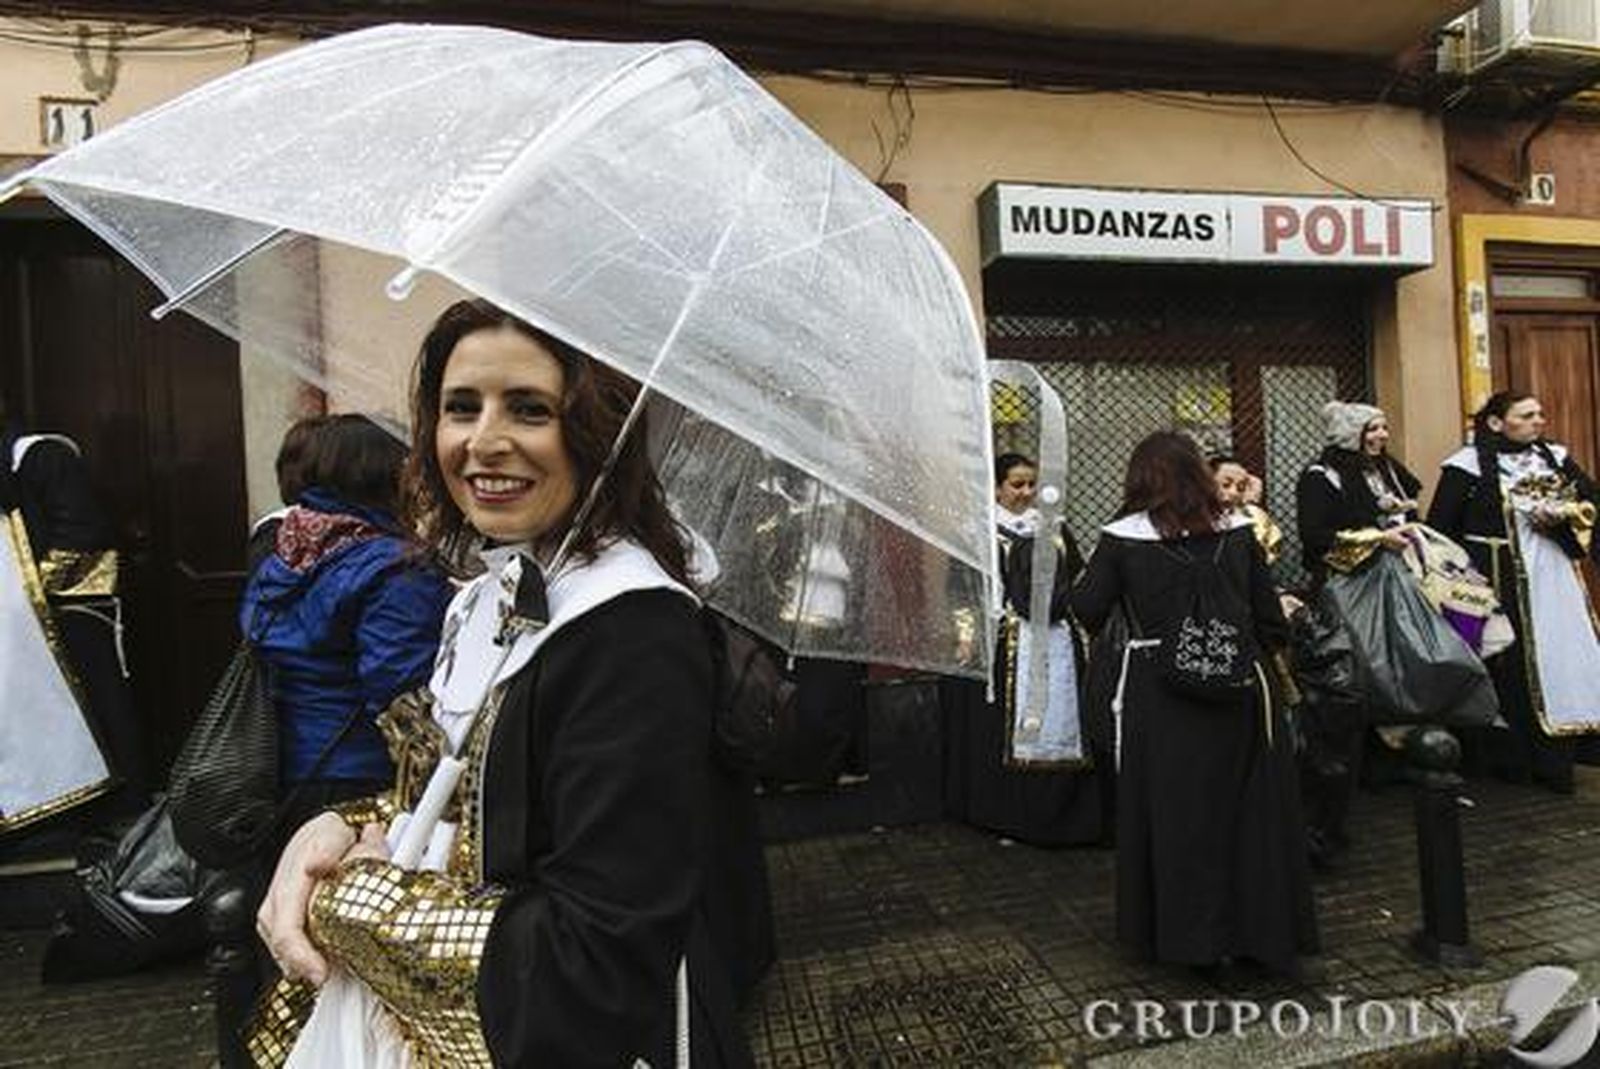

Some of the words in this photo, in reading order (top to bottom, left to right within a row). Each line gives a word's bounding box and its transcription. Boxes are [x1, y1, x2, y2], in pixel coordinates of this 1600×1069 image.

[51, 106, 95, 143] 11
[1010, 205, 1216, 242] MUDANZAS
[1261, 204, 1402, 257] POLI
